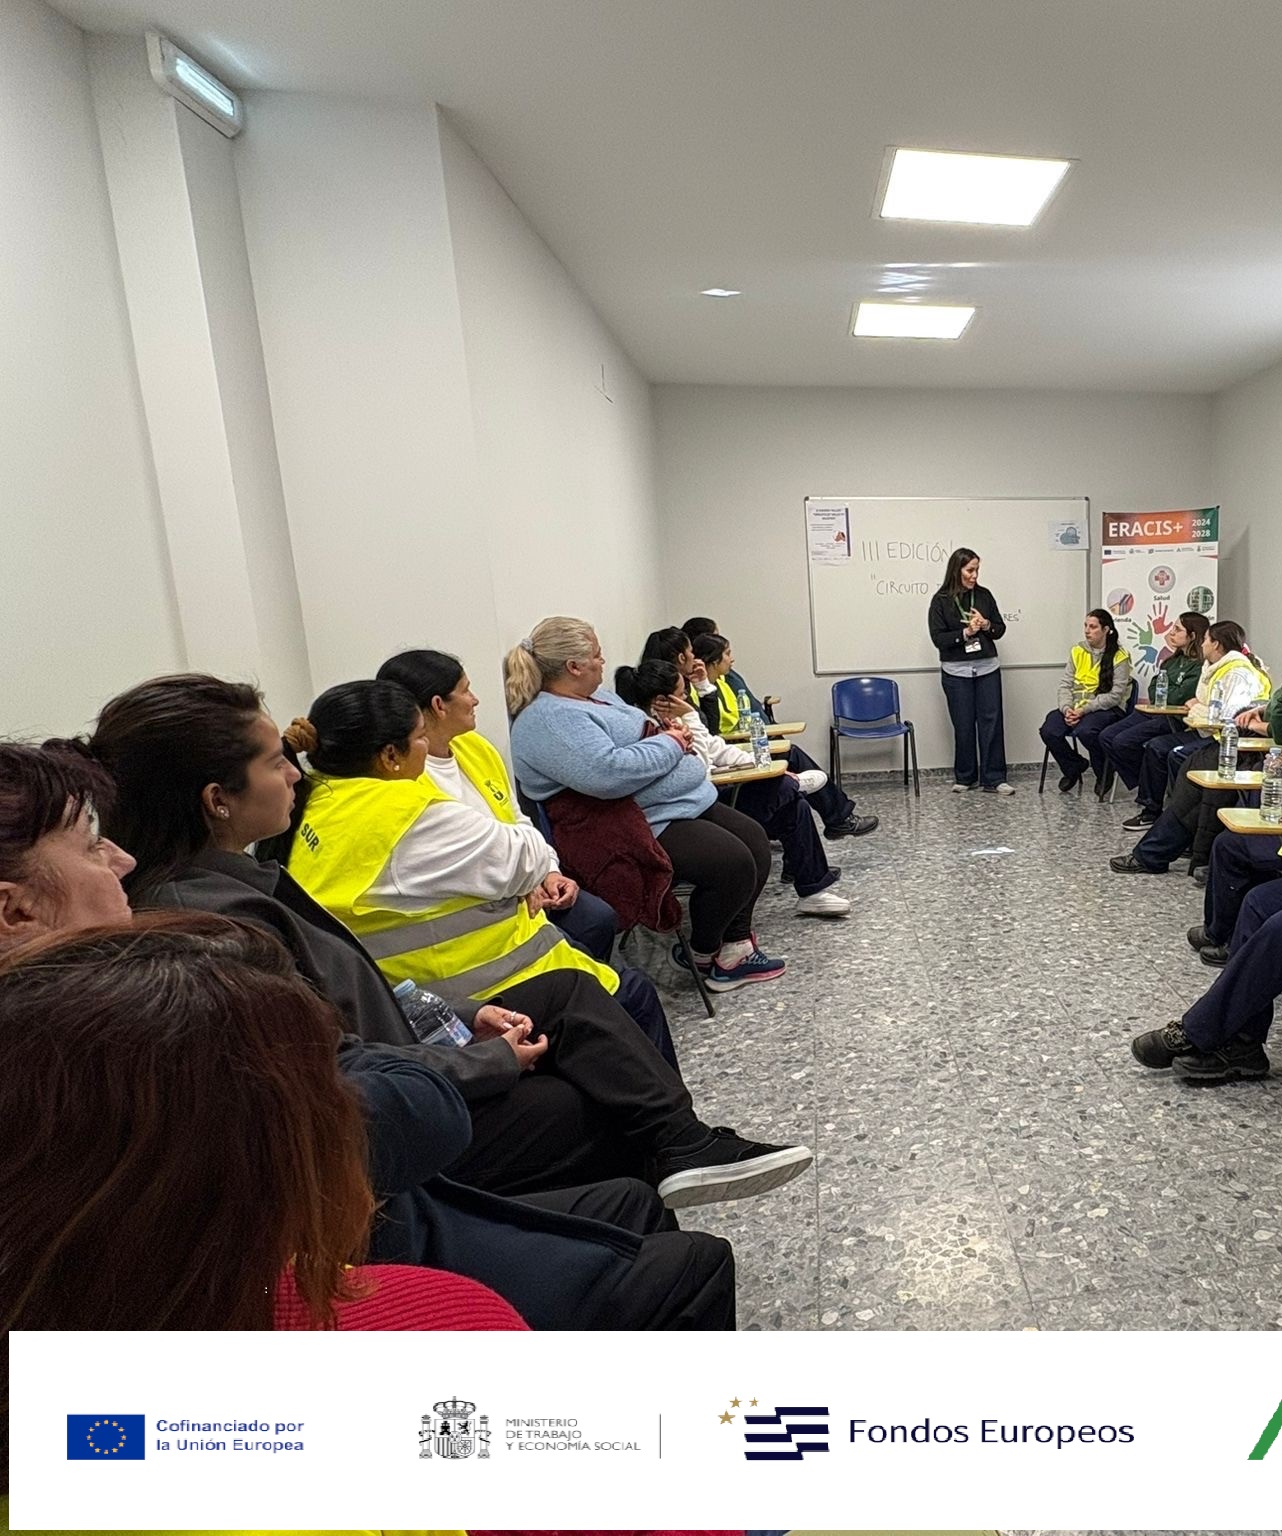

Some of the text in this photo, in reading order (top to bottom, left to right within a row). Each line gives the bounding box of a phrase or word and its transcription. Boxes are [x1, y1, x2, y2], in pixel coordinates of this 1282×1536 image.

[1109, 520, 1184, 538] ERACIS+
[1192, 518, 1211, 527] 2024
[1192, 530, 1211, 538] 2028
[862, 541, 880, 562] III
[301, 823, 319, 852] SUR
